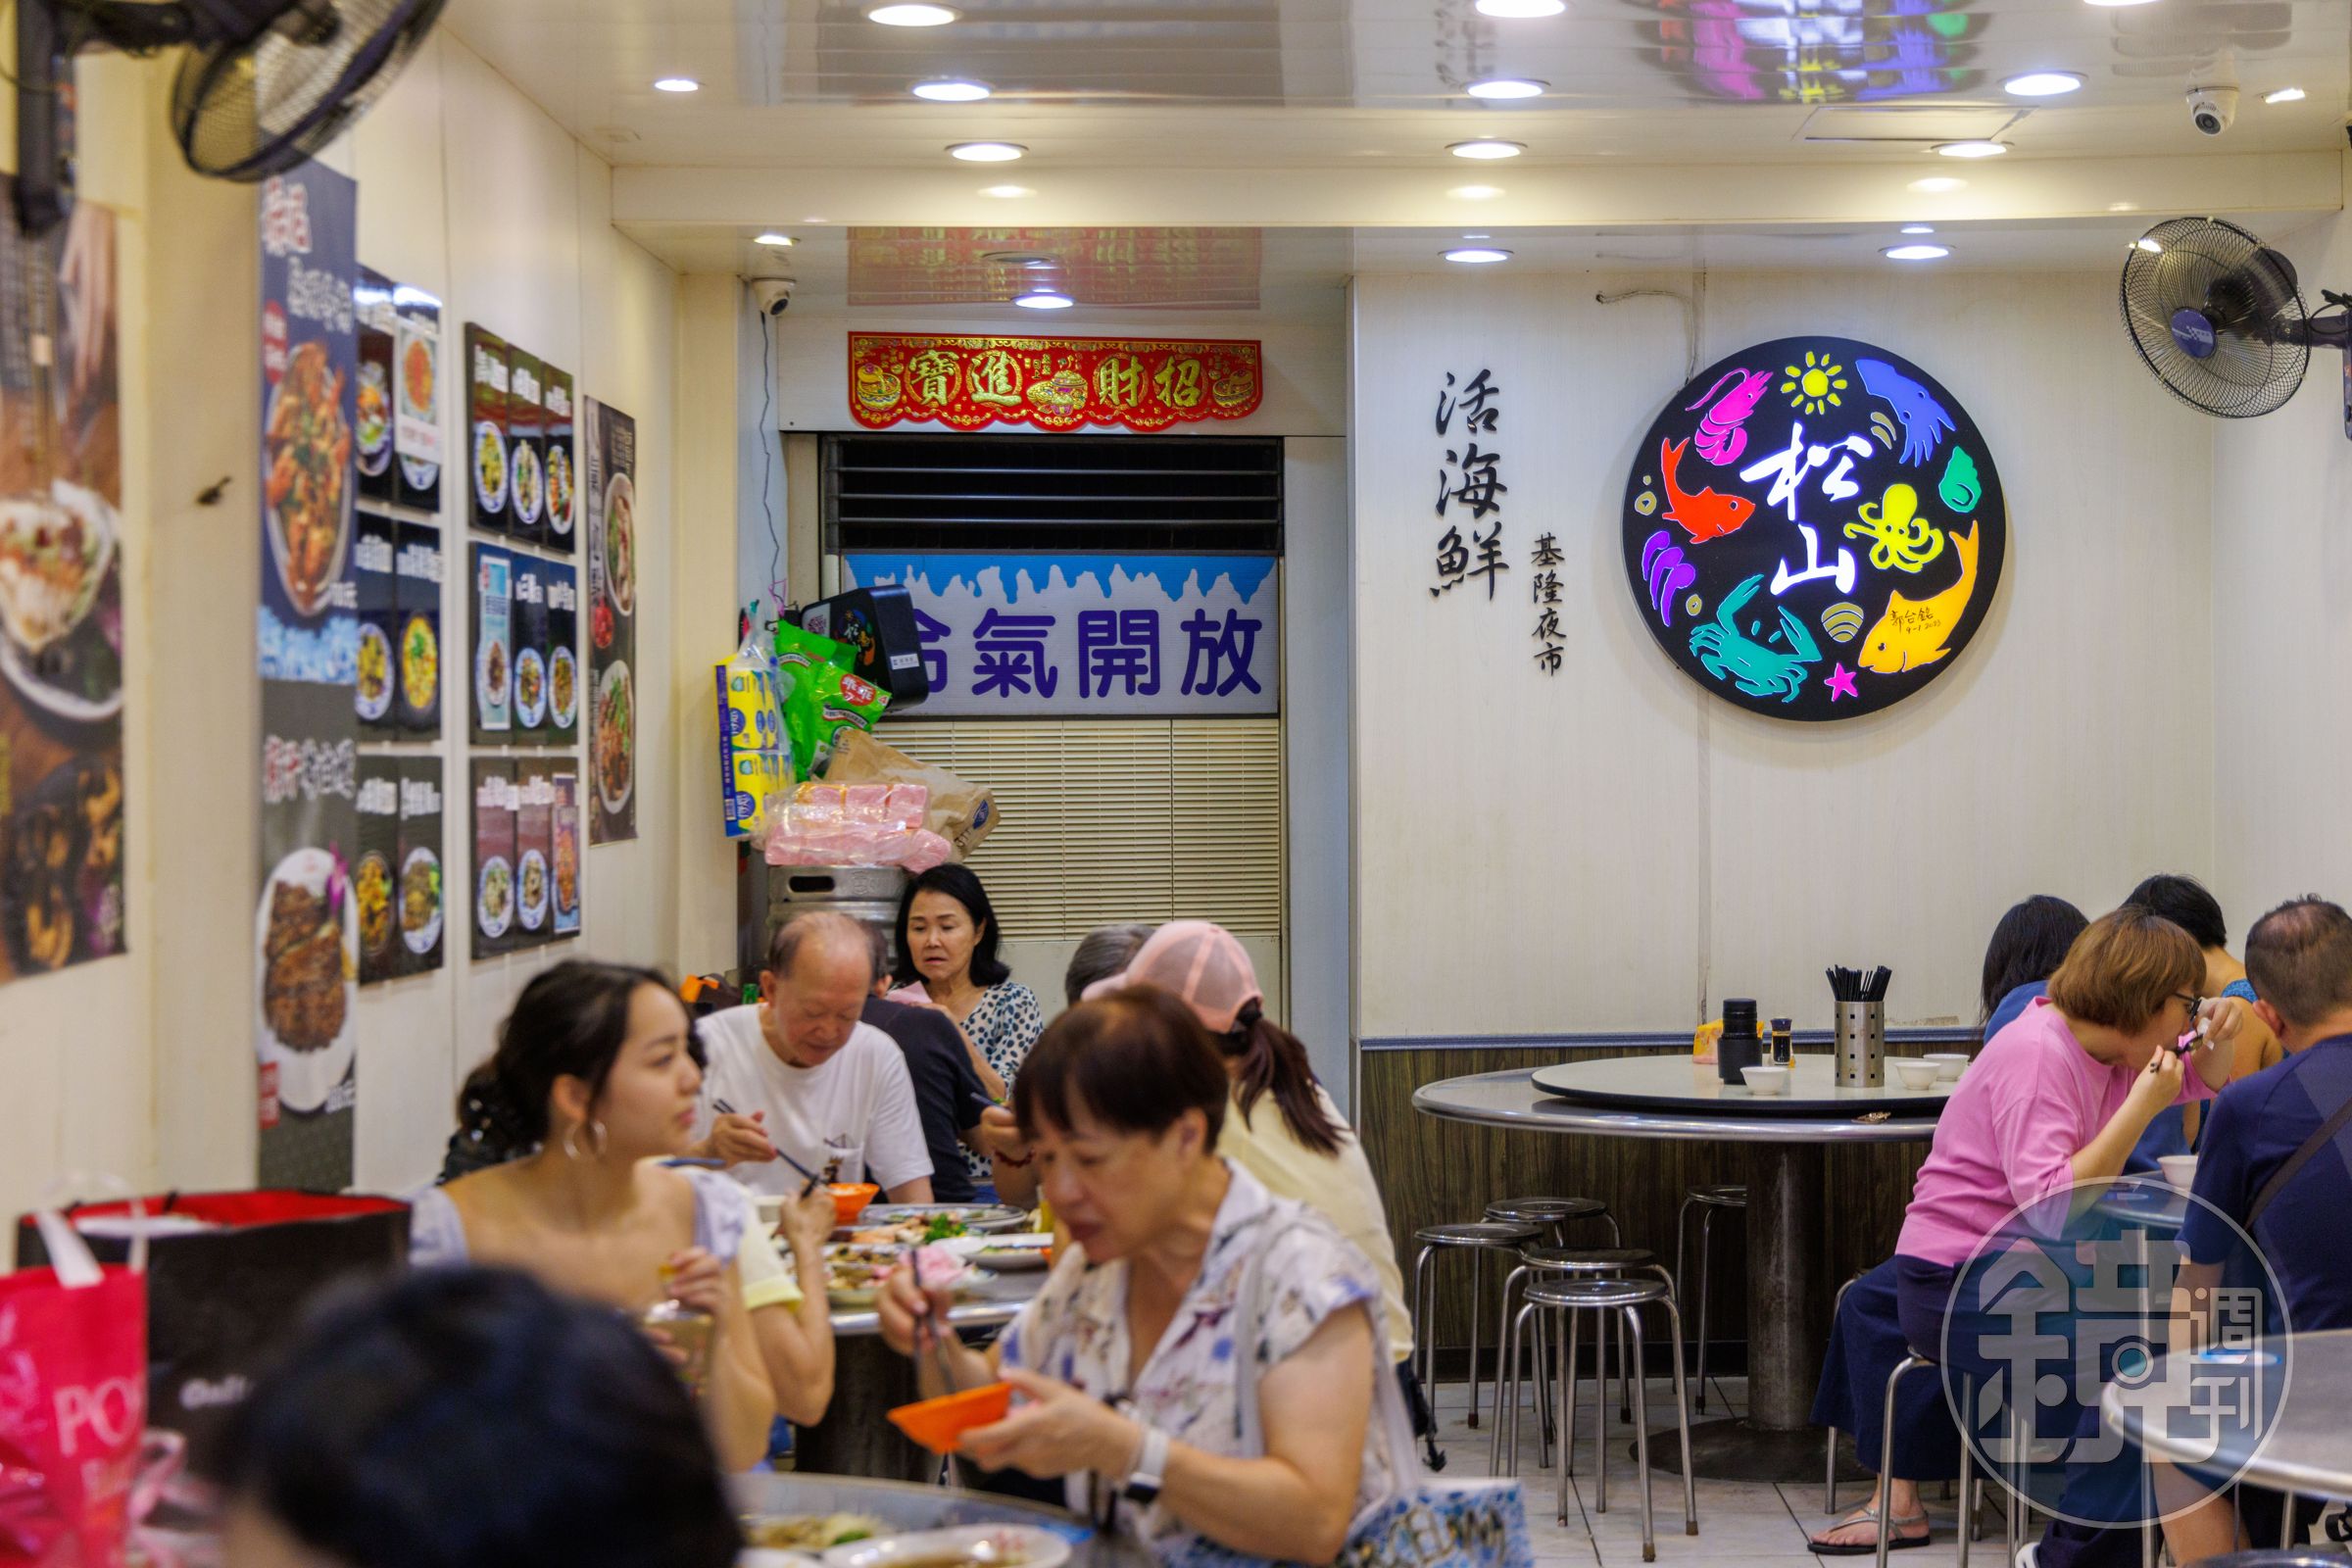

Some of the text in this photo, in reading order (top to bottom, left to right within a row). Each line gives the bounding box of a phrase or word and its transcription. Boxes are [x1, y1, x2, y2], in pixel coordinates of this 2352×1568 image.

[1429, 368, 1509, 602] 活海鮮
[1740, 421, 1873, 596] 松山
[1531, 532, 1567, 676] 基隆夜市
[1890, 607, 1934, 634] 郭台銘
